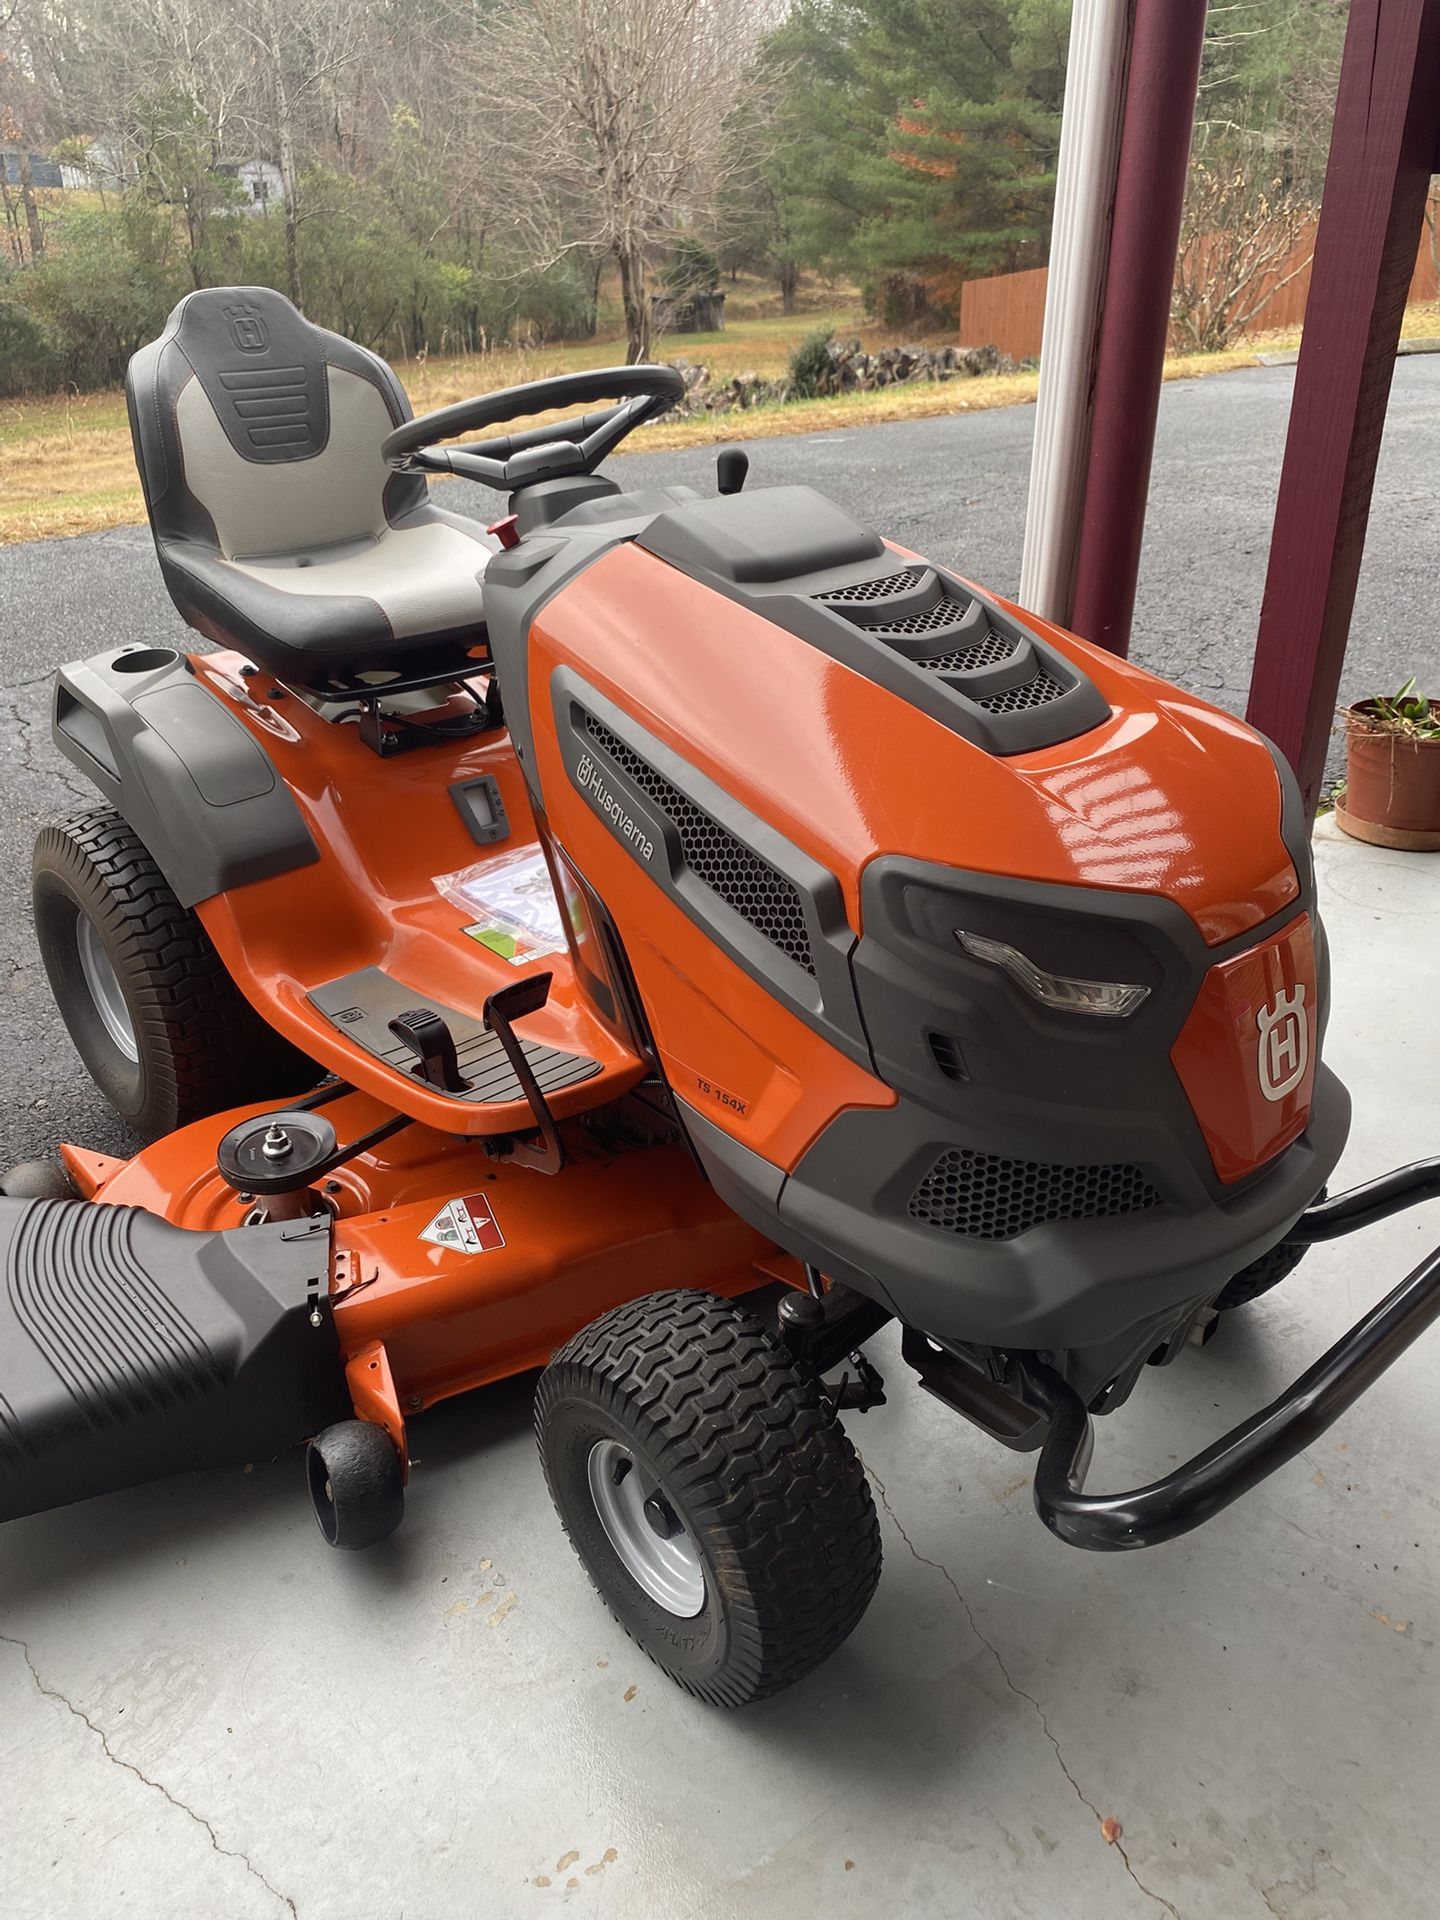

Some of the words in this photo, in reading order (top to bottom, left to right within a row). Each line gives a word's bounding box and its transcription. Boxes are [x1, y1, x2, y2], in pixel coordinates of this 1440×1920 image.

[588, 771, 654, 861] Husqvarna
[697, 1078, 711, 1093] TS
[715, 1090, 746, 1114] 154X
